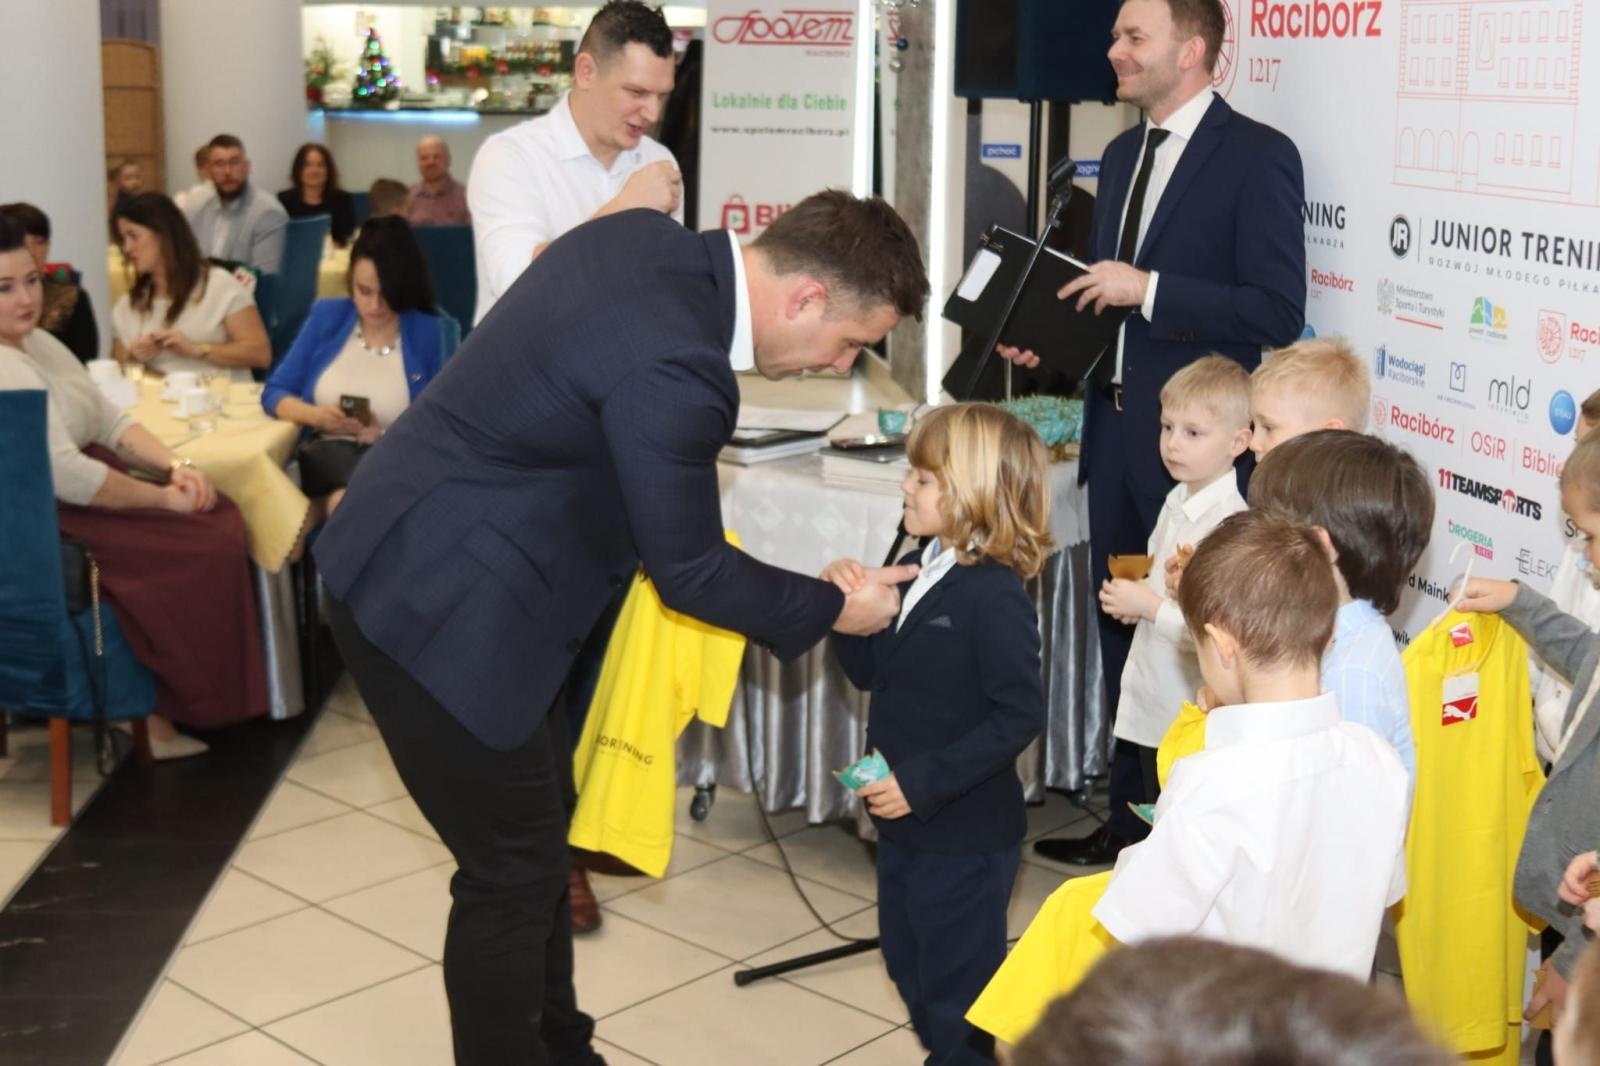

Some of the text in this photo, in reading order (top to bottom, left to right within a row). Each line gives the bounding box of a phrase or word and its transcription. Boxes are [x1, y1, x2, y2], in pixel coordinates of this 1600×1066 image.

[1248, 57, 1281, 92] 1217
[713, 92, 847, 111] Lokalnie dla Ciebie
[1430, 219, 1600, 272] JUNIOR TRENI
[1310, 268, 1354, 292] Racibórz
[1428, 256, 1479, 274] ROZWÓJ
[1486, 266, 1551, 287] MŁODEGO
[1396, 284, 1433, 301] Ministerstwo
[1388, 354, 1426, 377] Wodociągi
[1488, 375, 1532, 410] mld
[1391, 405, 1455, 444] Racibórz
[1471, 431, 1506, 460] OSiR
[1448, 519, 1493, 548] DROGERIA
[1417, 577, 1450, 602] Maink
